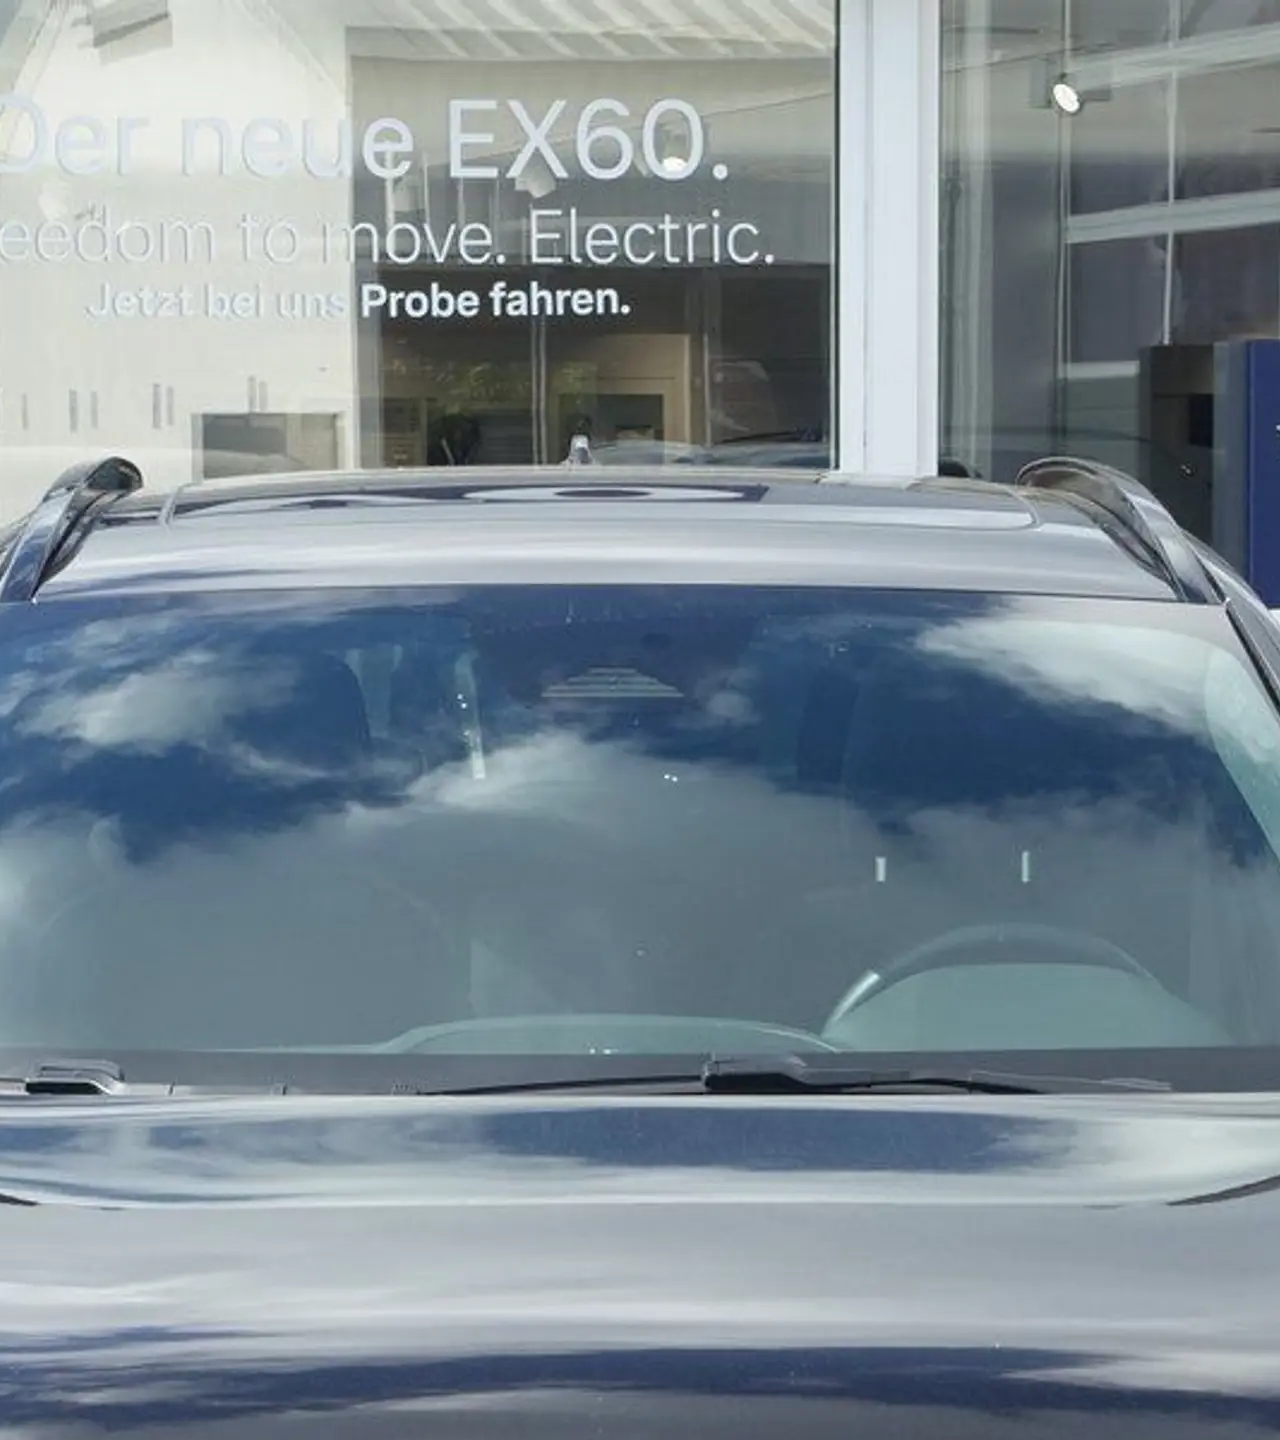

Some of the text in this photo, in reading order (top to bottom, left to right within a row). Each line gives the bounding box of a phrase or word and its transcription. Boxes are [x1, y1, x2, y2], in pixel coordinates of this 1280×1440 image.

[181, 116, 414, 179] neue
[449, 98, 729, 180] EX60.
[240, 212, 299, 264] to
[323, 219, 507, 264] move.
[531, 207, 775, 264] Electric.
[85, 281, 631, 320] Jetzt bei uns Probe fahren.
